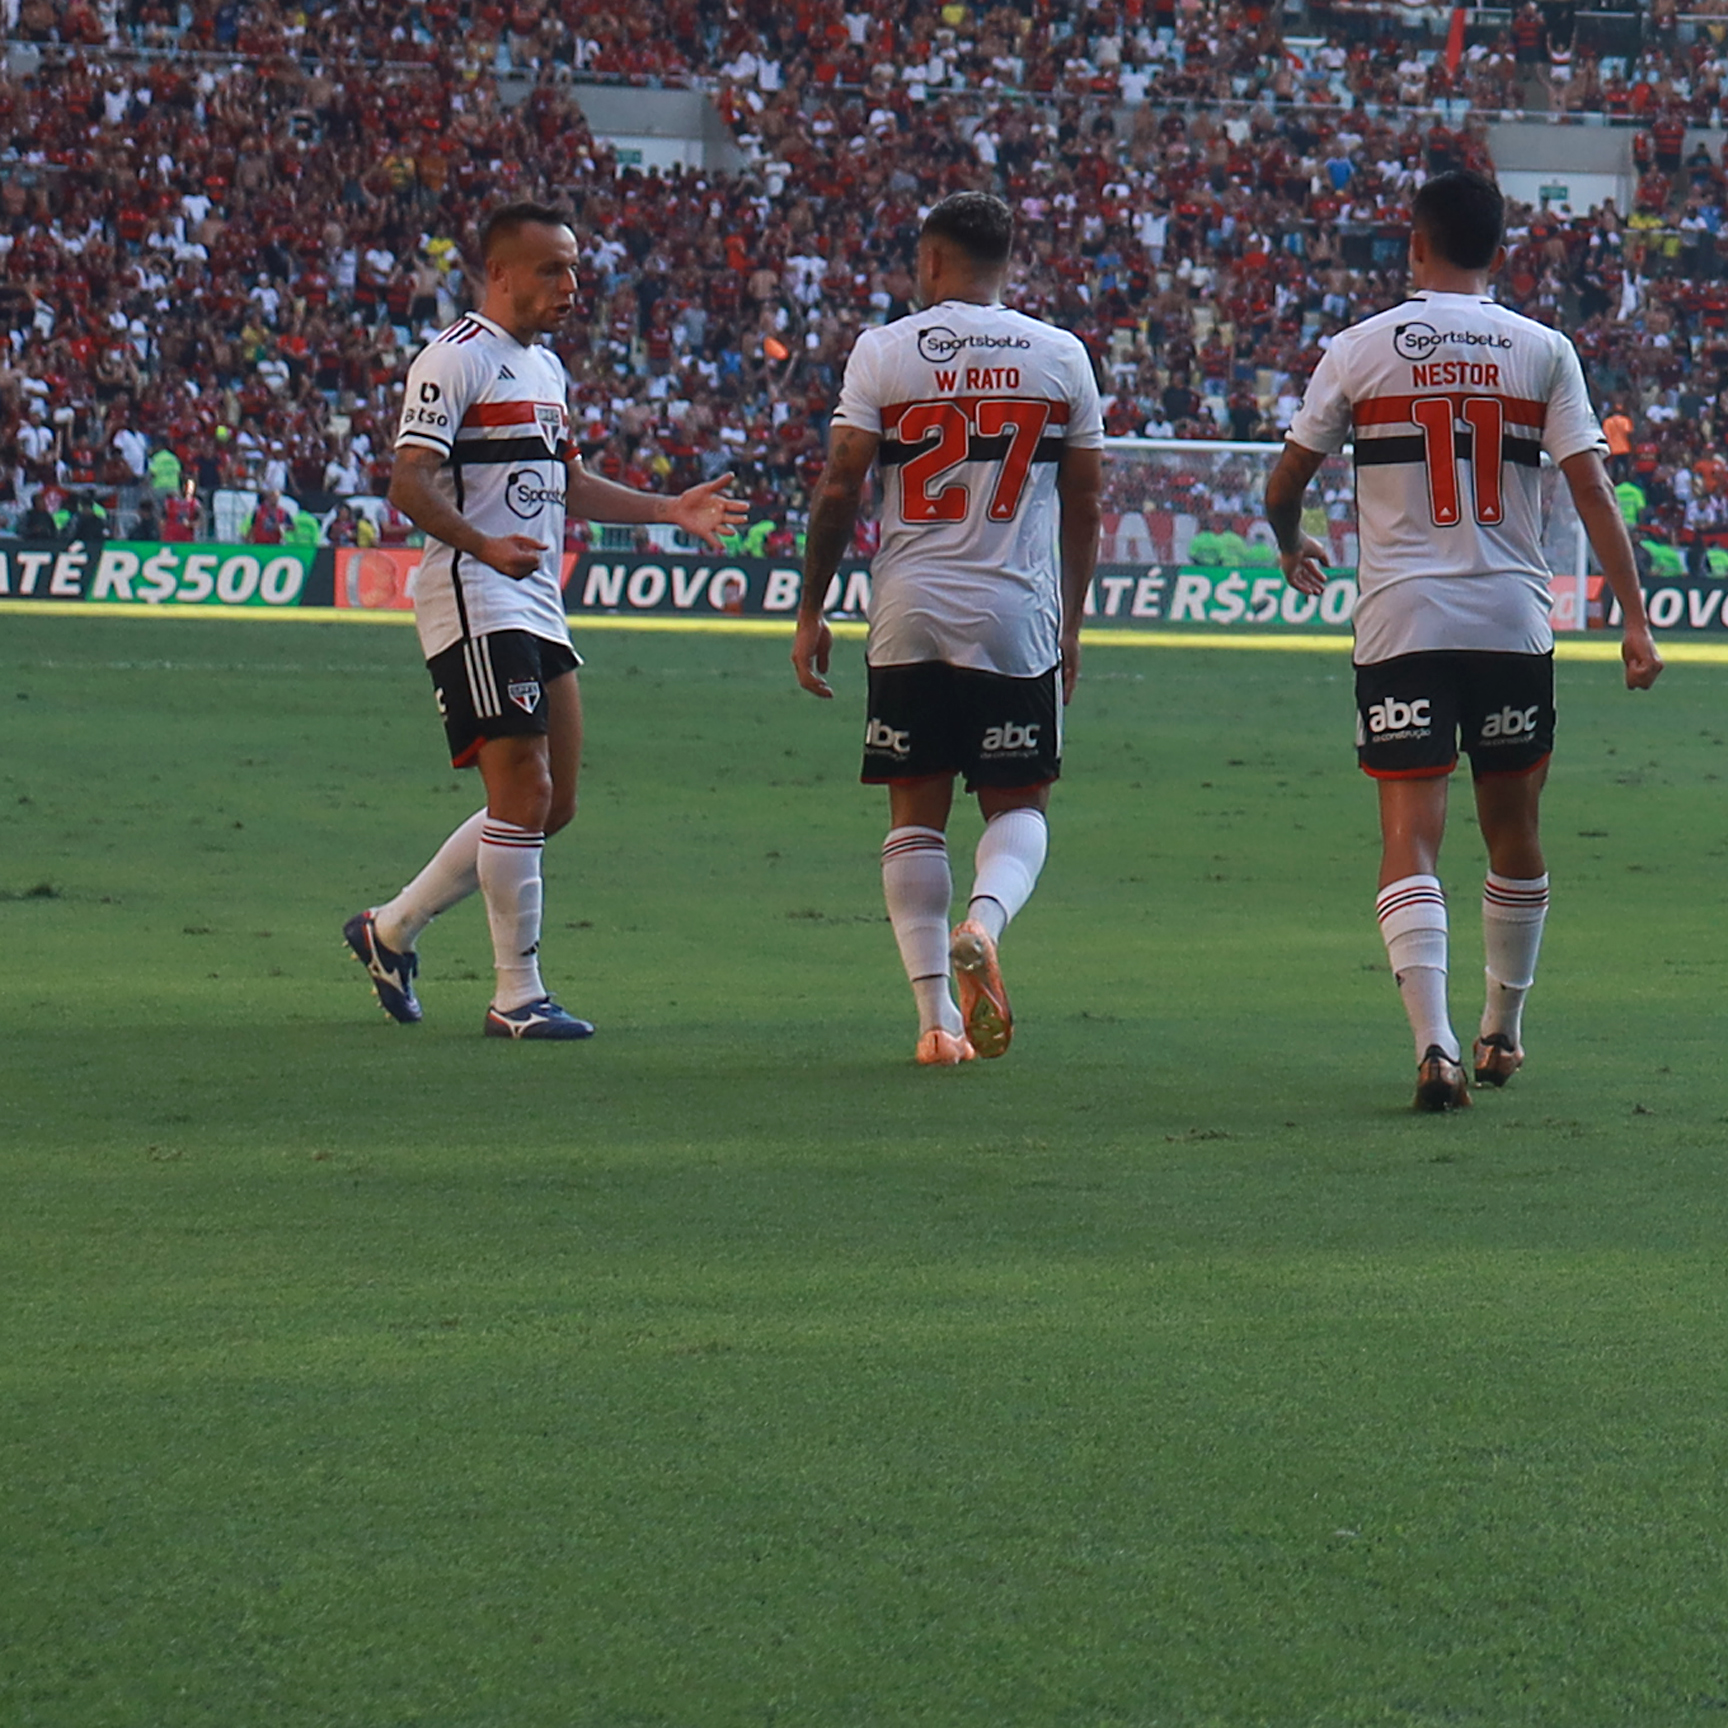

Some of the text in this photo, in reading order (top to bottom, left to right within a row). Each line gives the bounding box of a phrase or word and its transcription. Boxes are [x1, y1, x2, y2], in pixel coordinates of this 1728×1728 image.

[926, 334, 1031, 354] Sportsbet.io
[1405, 331, 1513, 351] Sportsbet.io
[935, 368, 1020, 393] W RATO
[1411, 362, 1500, 388] NESTOR
[898, 398, 1050, 524] 27
[1411, 398, 1505, 527] 11
[0, 541, 304, 605] TÉ R$500
[584, 564, 747, 610] NOVO
[1169, 571, 1356, 624] R$500
[1368, 697, 1431, 734] abc
[1481, 704, 1539, 738] abc
[982, 721, 1040, 751] abc
